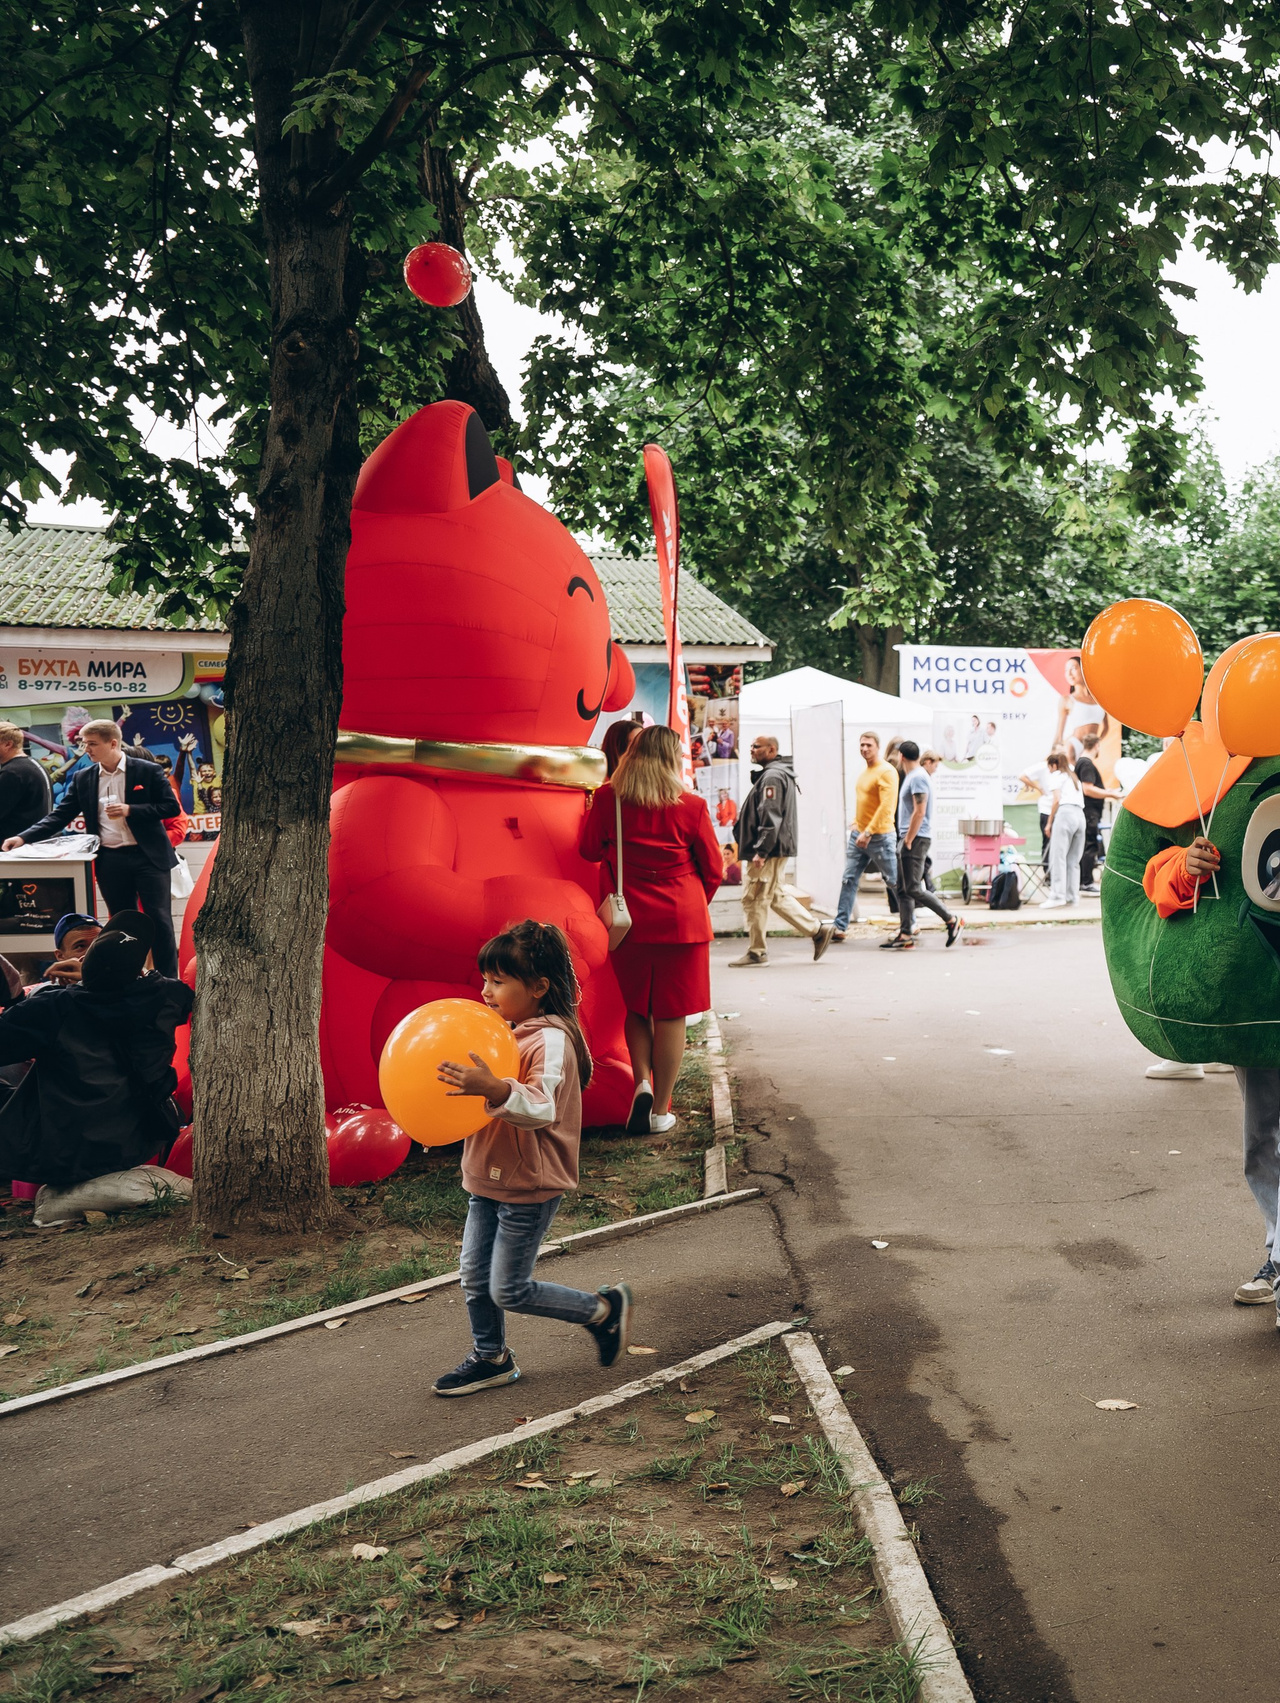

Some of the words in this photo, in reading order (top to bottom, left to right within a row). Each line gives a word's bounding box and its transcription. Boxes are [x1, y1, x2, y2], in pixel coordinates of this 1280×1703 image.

[18, 658, 81, 677] БУХТА
[87, 660, 147, 678] МИРА
[18, 680, 147, 692] 8-977-256-50-82
